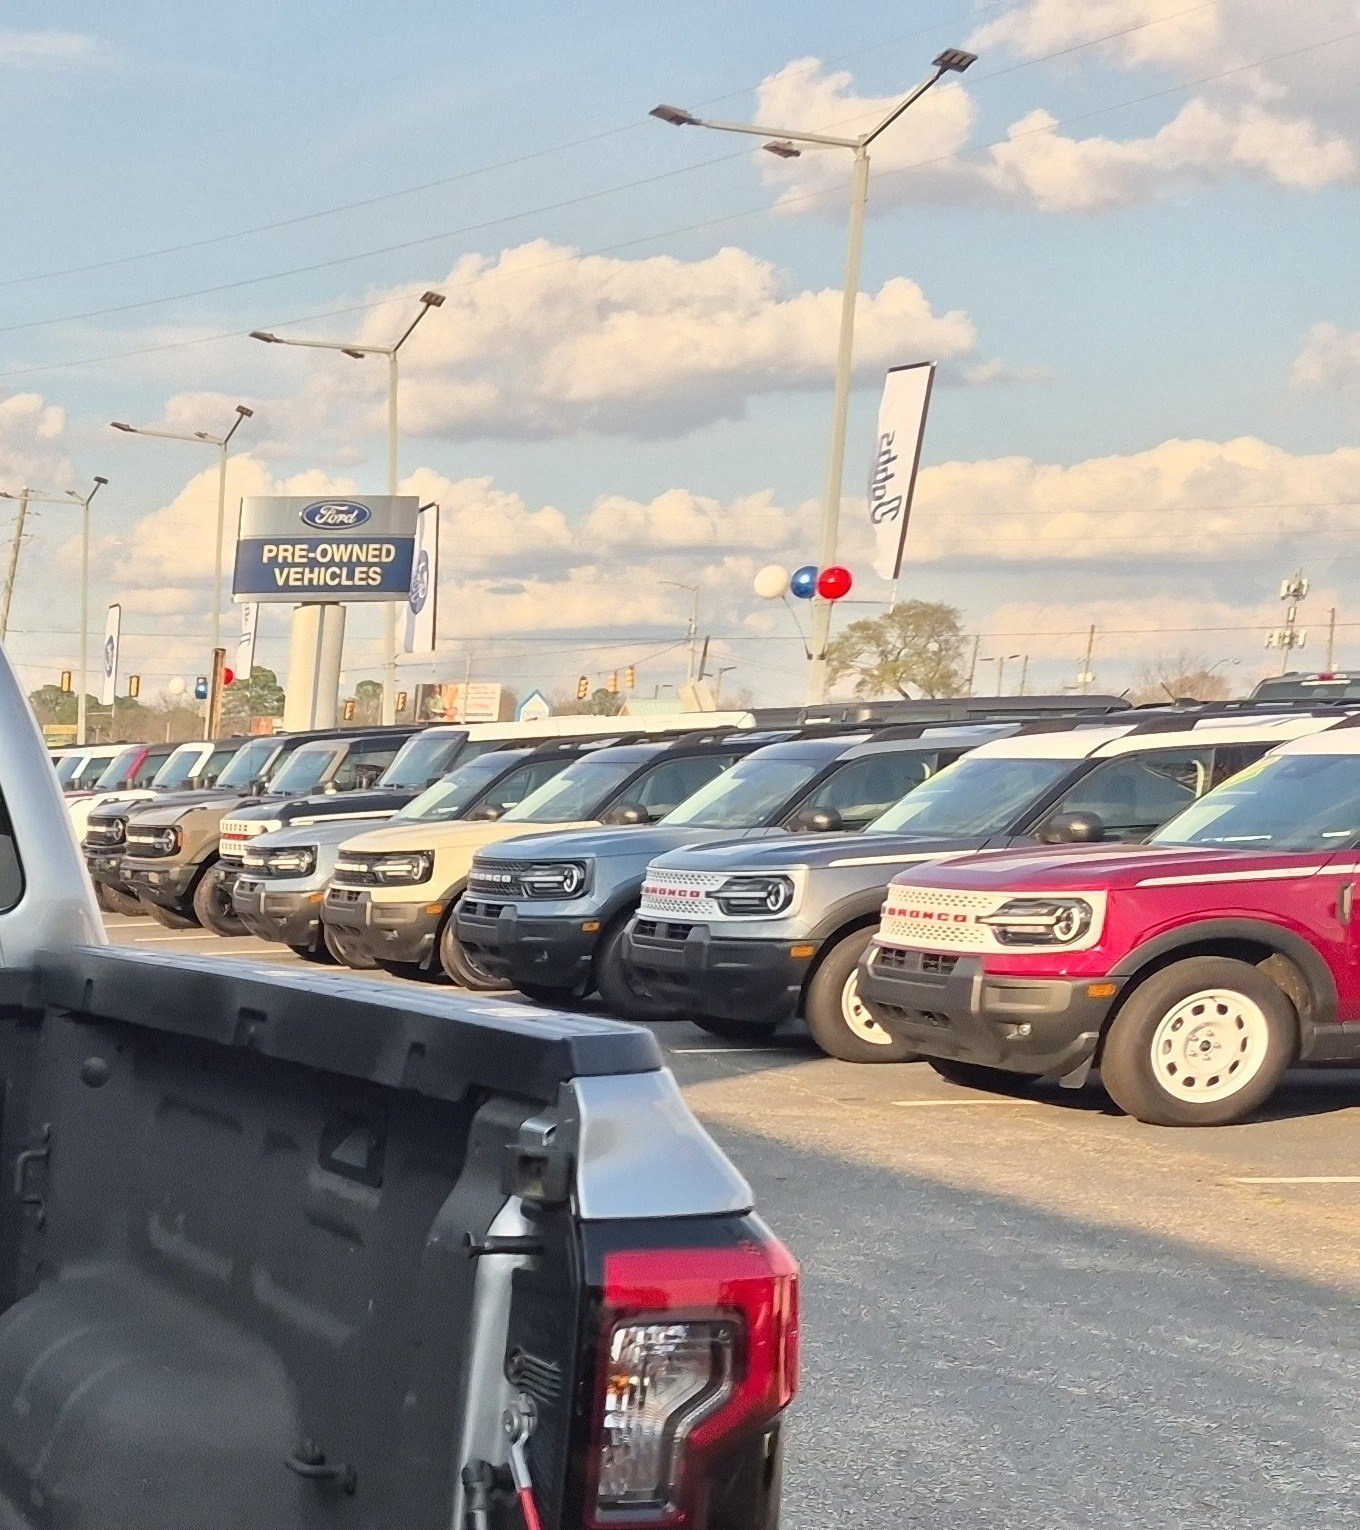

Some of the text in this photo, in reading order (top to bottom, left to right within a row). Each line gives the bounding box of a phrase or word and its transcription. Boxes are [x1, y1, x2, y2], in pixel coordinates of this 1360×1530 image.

[314, 504, 358, 524] Ford
[262, 543, 396, 564] PRE-OWNED
[274, 566, 382, 586] VEHICLES
[644, 886, 700, 898] BRONCO
[887, 907, 967, 923] BRONCO
